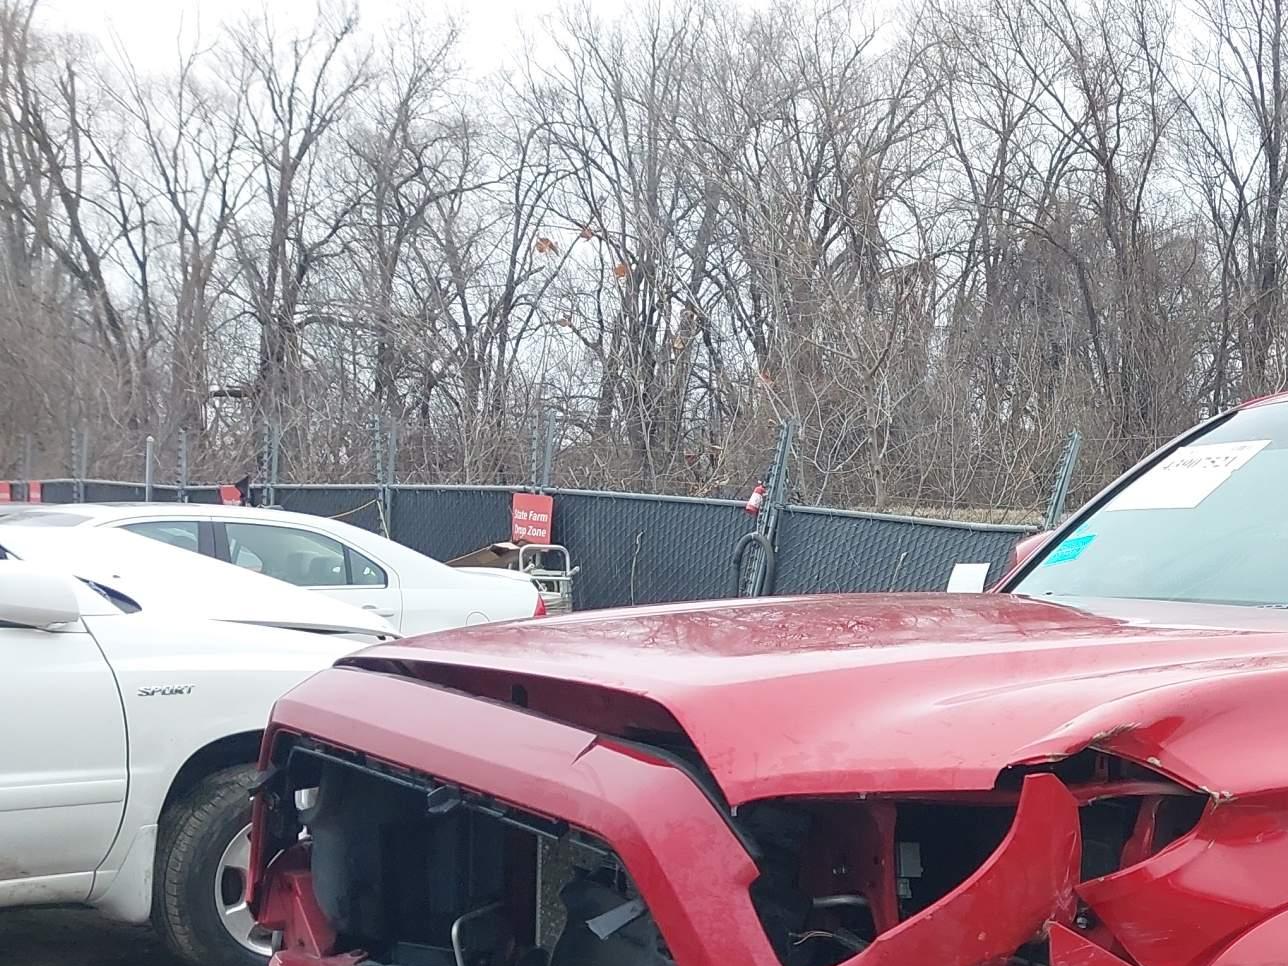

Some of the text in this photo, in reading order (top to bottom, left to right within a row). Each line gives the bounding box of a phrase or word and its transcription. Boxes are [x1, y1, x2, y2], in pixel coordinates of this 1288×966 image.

[528, 510, 548, 523] Farm
[527, 525, 547, 538] Zone
[137, 683, 195, 697] SPORT
